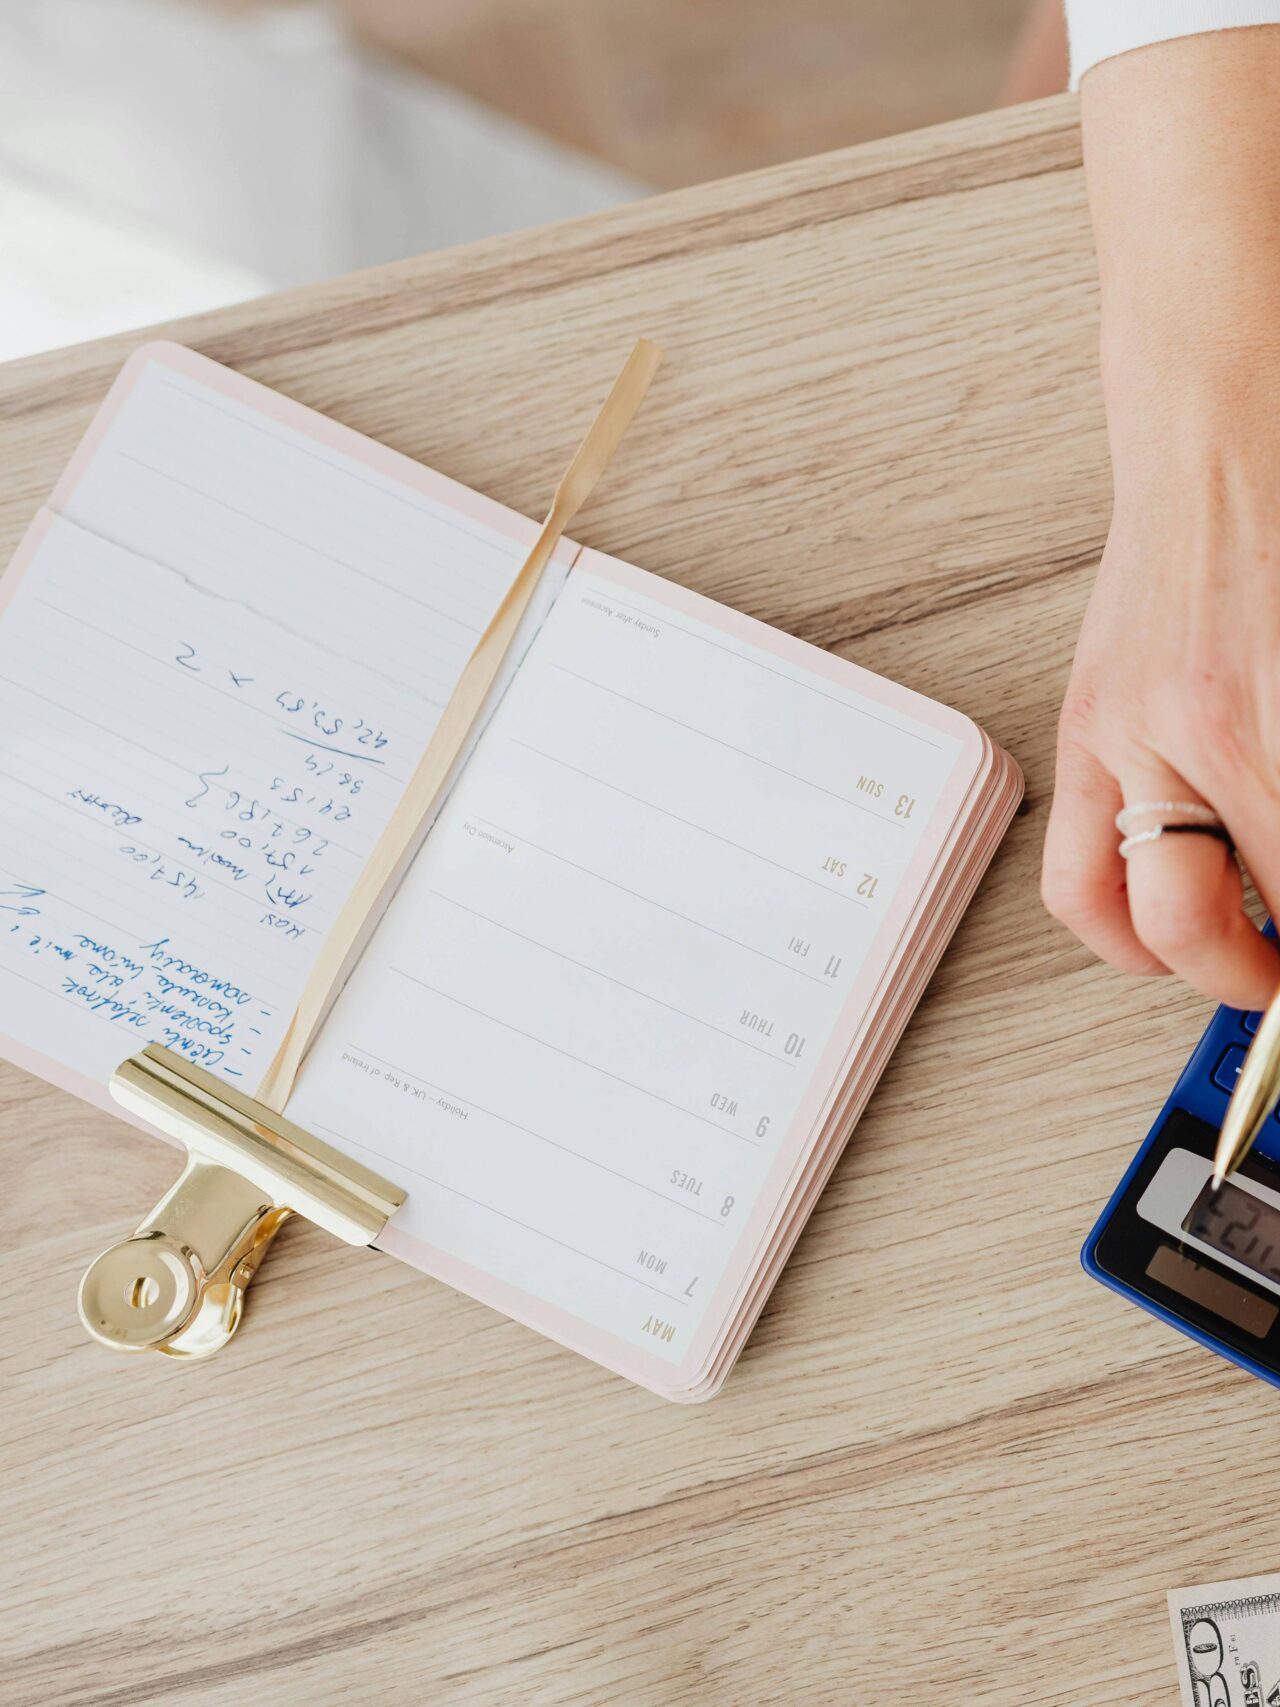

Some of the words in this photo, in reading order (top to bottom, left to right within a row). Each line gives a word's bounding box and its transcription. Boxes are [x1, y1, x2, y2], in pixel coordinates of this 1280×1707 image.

[855, 775, 884, 798] SUN
[894, 794, 915, 819] 13
[821, 856, 847, 877] SAT
[856, 873, 878, 898] 12
[787, 936, 811, 957] FRI
[823, 954, 842, 978] 11
[739, 1009, 774, 1037] THUR
[783, 1032, 806, 1058] 10
[409, 1085, 428, 1101] UK
[710, 1092, 738, 1116] WED
[433, 1095, 470, 1122] Holiday
[755, 1116, 770, 1138] 9
[669, 1169, 703, 1196] TUES
[720, 1195, 735, 1217] 8
[636, 1249, 667, 1274] MON
[684, 1276, 698, 1297] 7
[641, 1315, 676, 1343] MAY
